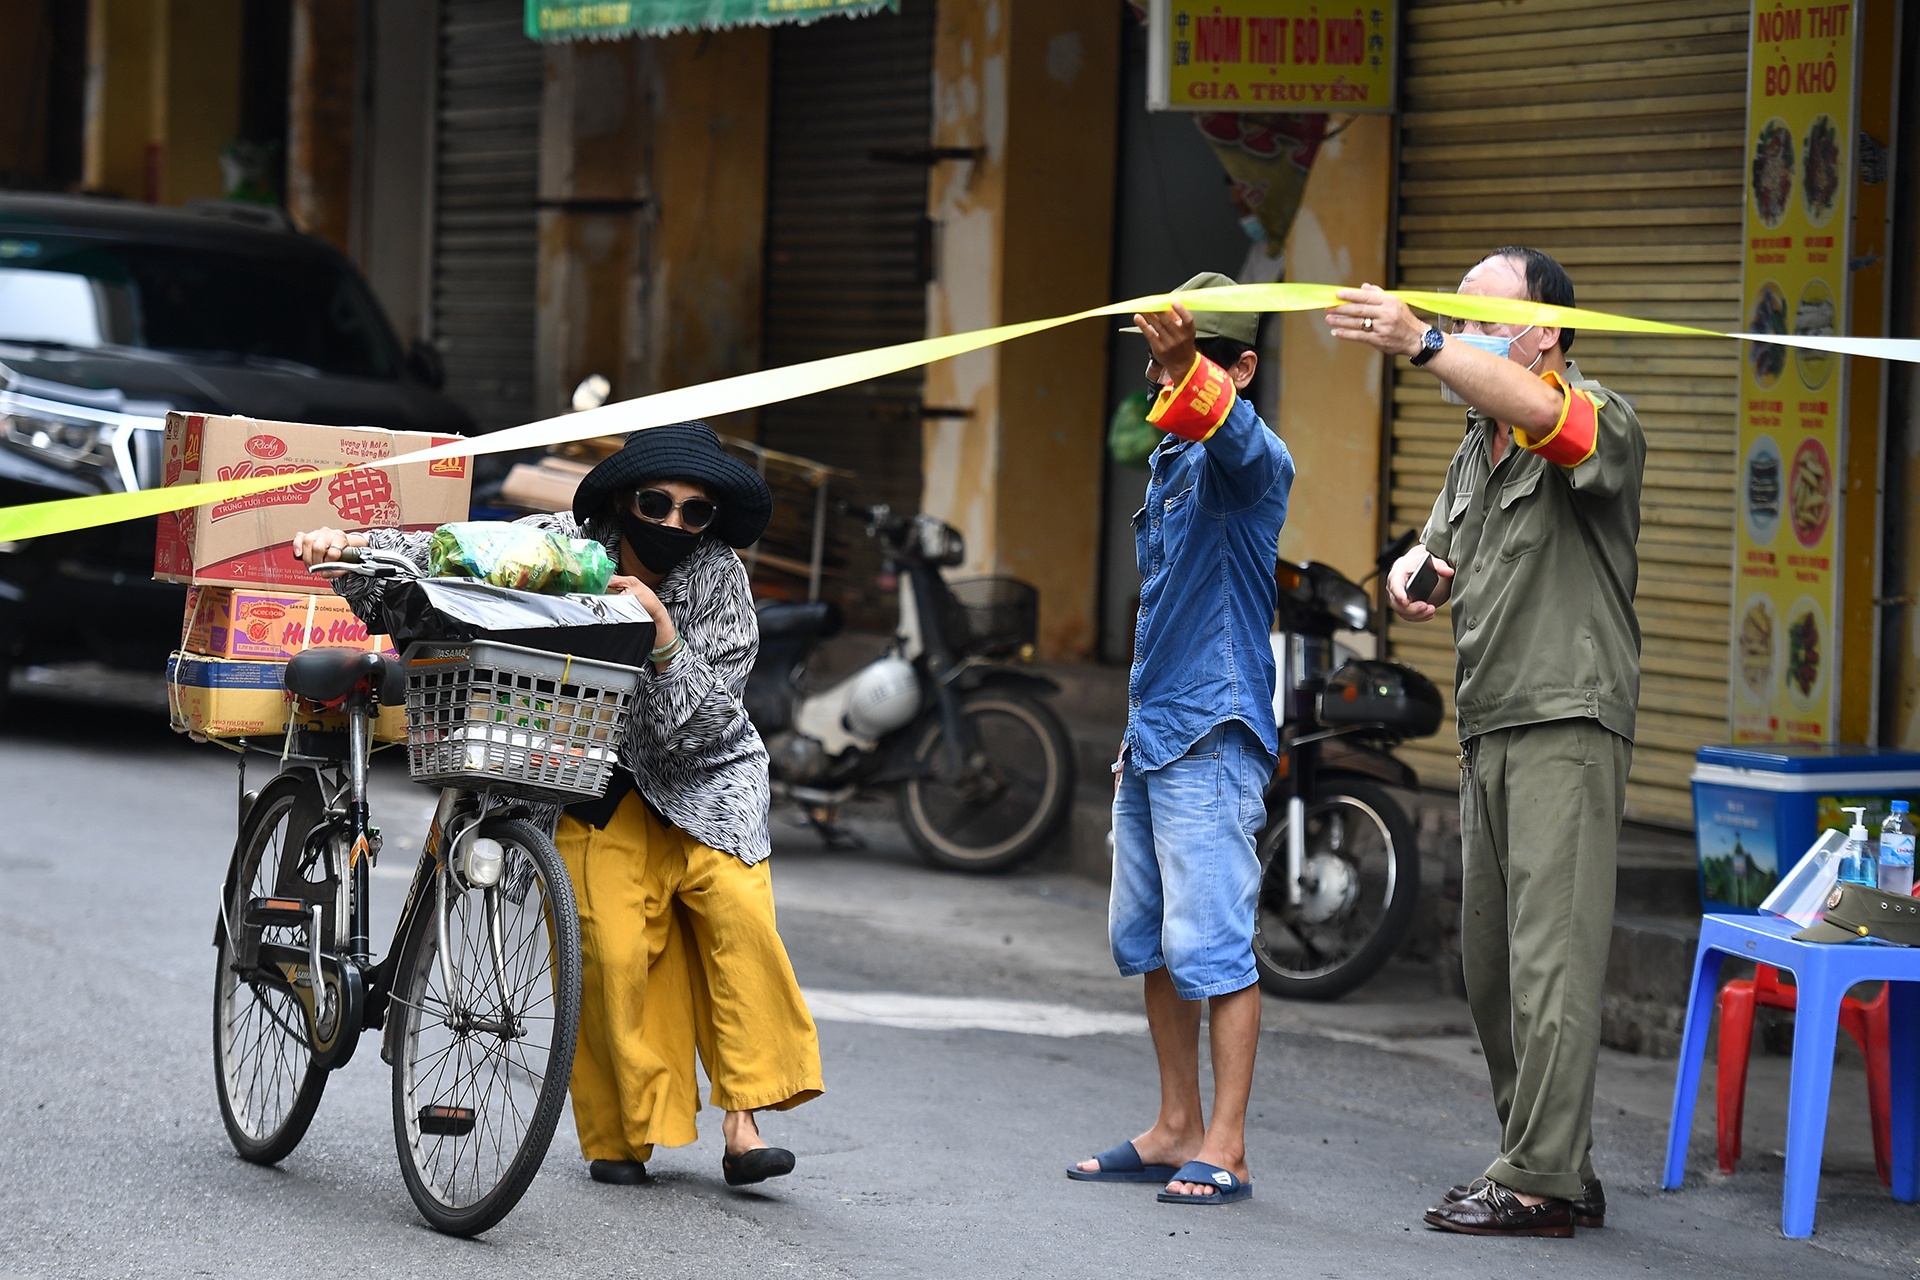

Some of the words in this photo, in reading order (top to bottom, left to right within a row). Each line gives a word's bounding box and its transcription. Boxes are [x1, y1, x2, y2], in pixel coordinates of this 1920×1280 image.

[1757, 2, 1802, 52] NỘM
[1807, 4, 1850, 47] THỊT
[1765, 56, 1792, 97] BÒ
[1796, 52, 1837, 94] KHÔ
[1188, 81, 1240, 101] GIA
[1190, 379, 1222, 416] BẢO
[251, 438, 279, 457] Richy
[439, 649, 466, 658] ASAMA
